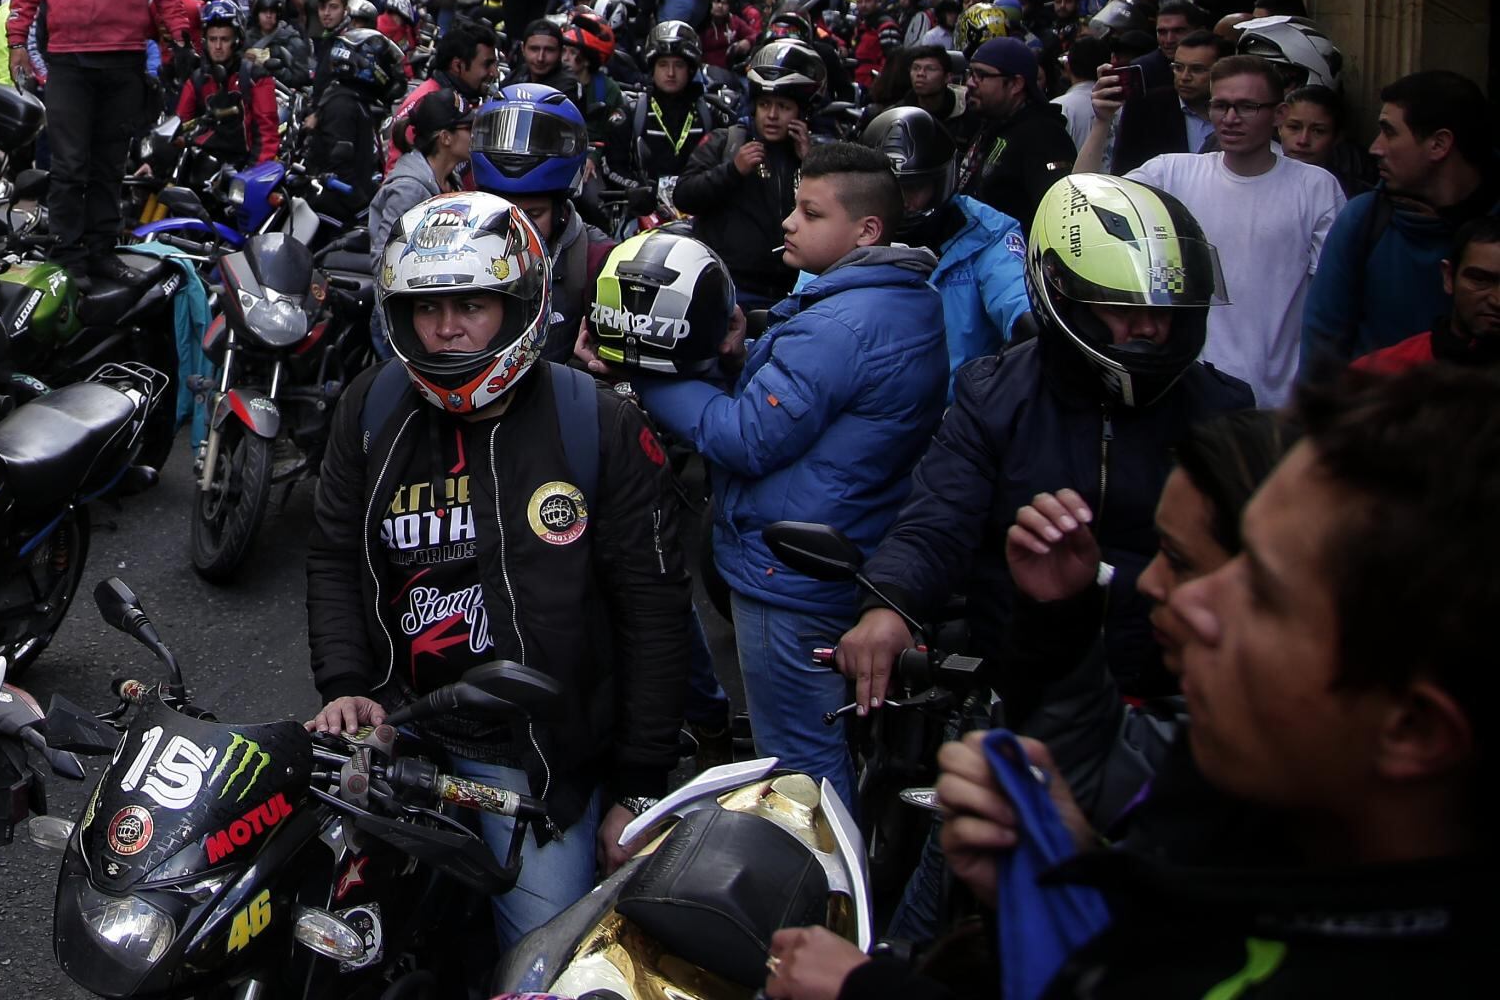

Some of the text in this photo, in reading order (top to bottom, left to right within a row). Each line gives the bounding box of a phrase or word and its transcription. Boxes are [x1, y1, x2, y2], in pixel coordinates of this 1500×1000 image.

[121, 726, 216, 809] 15
[206, 793, 293, 864] MOTUL
[227, 888, 271, 953] 46
